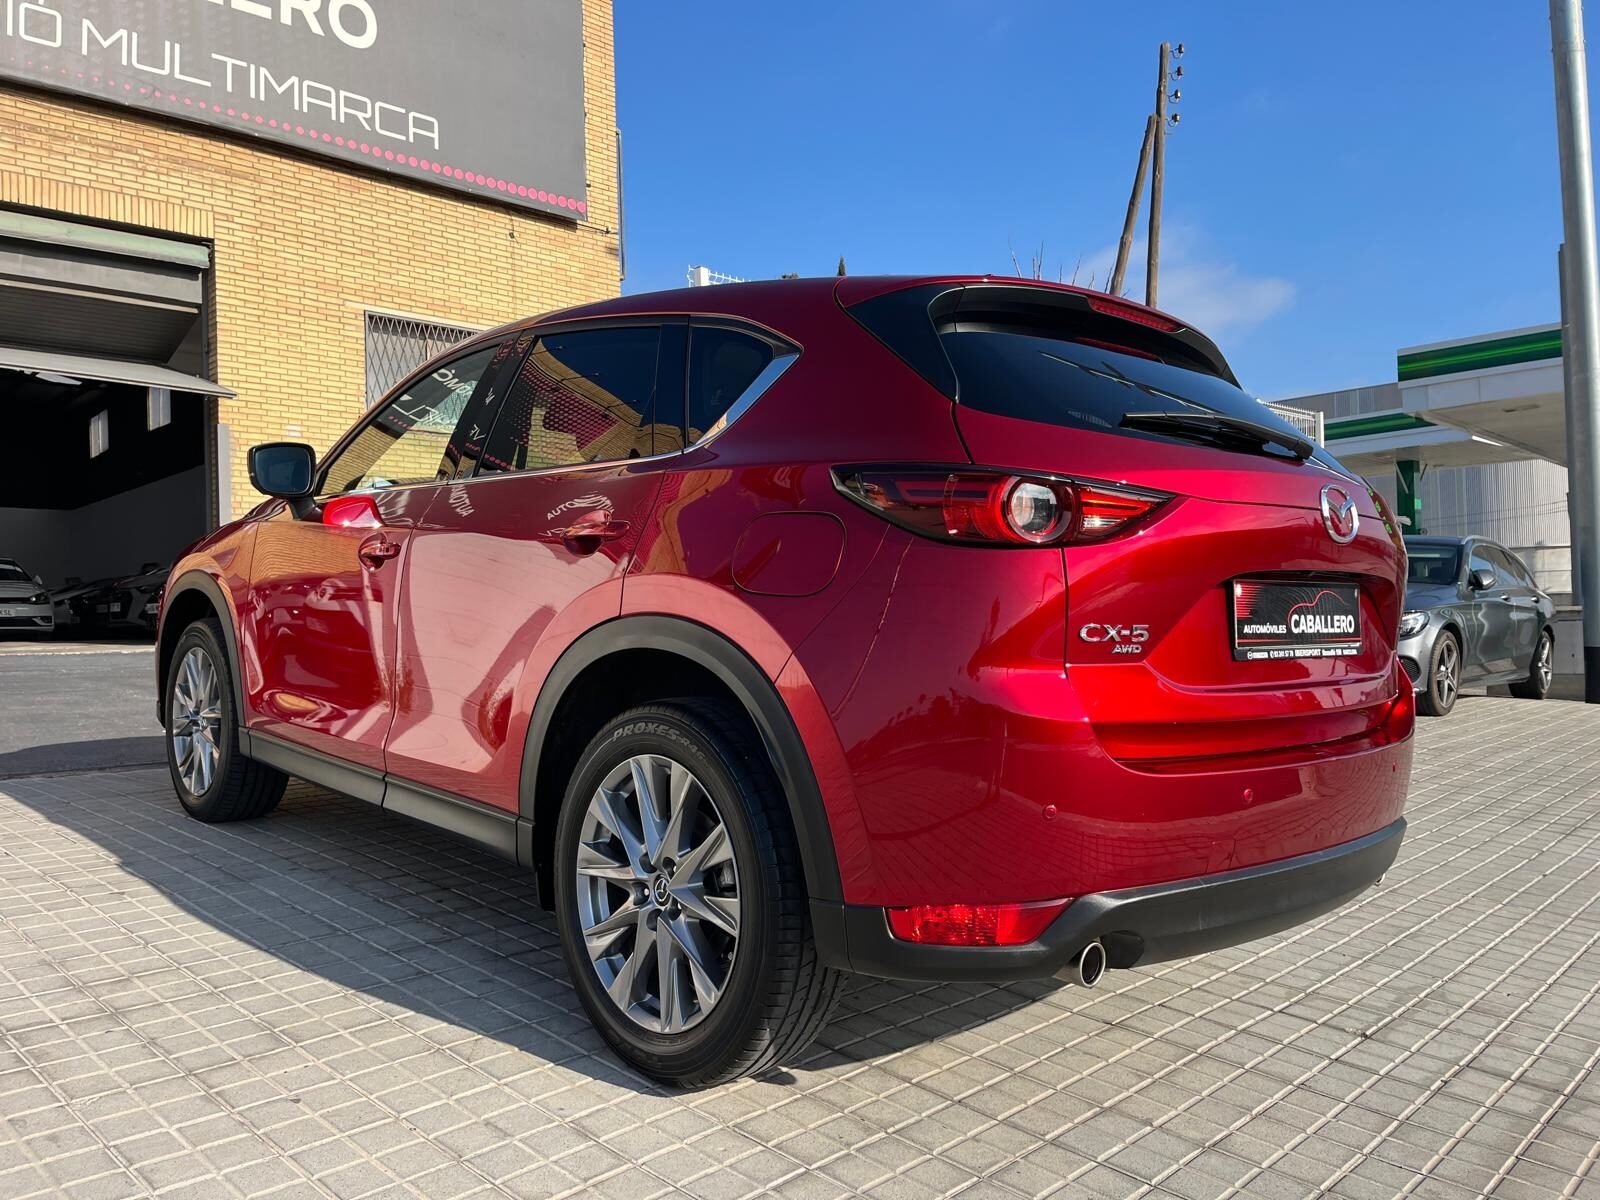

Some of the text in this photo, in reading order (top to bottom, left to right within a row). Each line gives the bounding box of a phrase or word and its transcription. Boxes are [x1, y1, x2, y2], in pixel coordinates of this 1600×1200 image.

[81, 18, 440, 150] MULTIMARCA
[1080, 622, 1150, 642] CX-5
[1243, 614, 1355, 634] AUTOMÓVILES CABALLERO
[1112, 644, 1142, 654] AWD
[613, 722, 680, 741] PROXES
